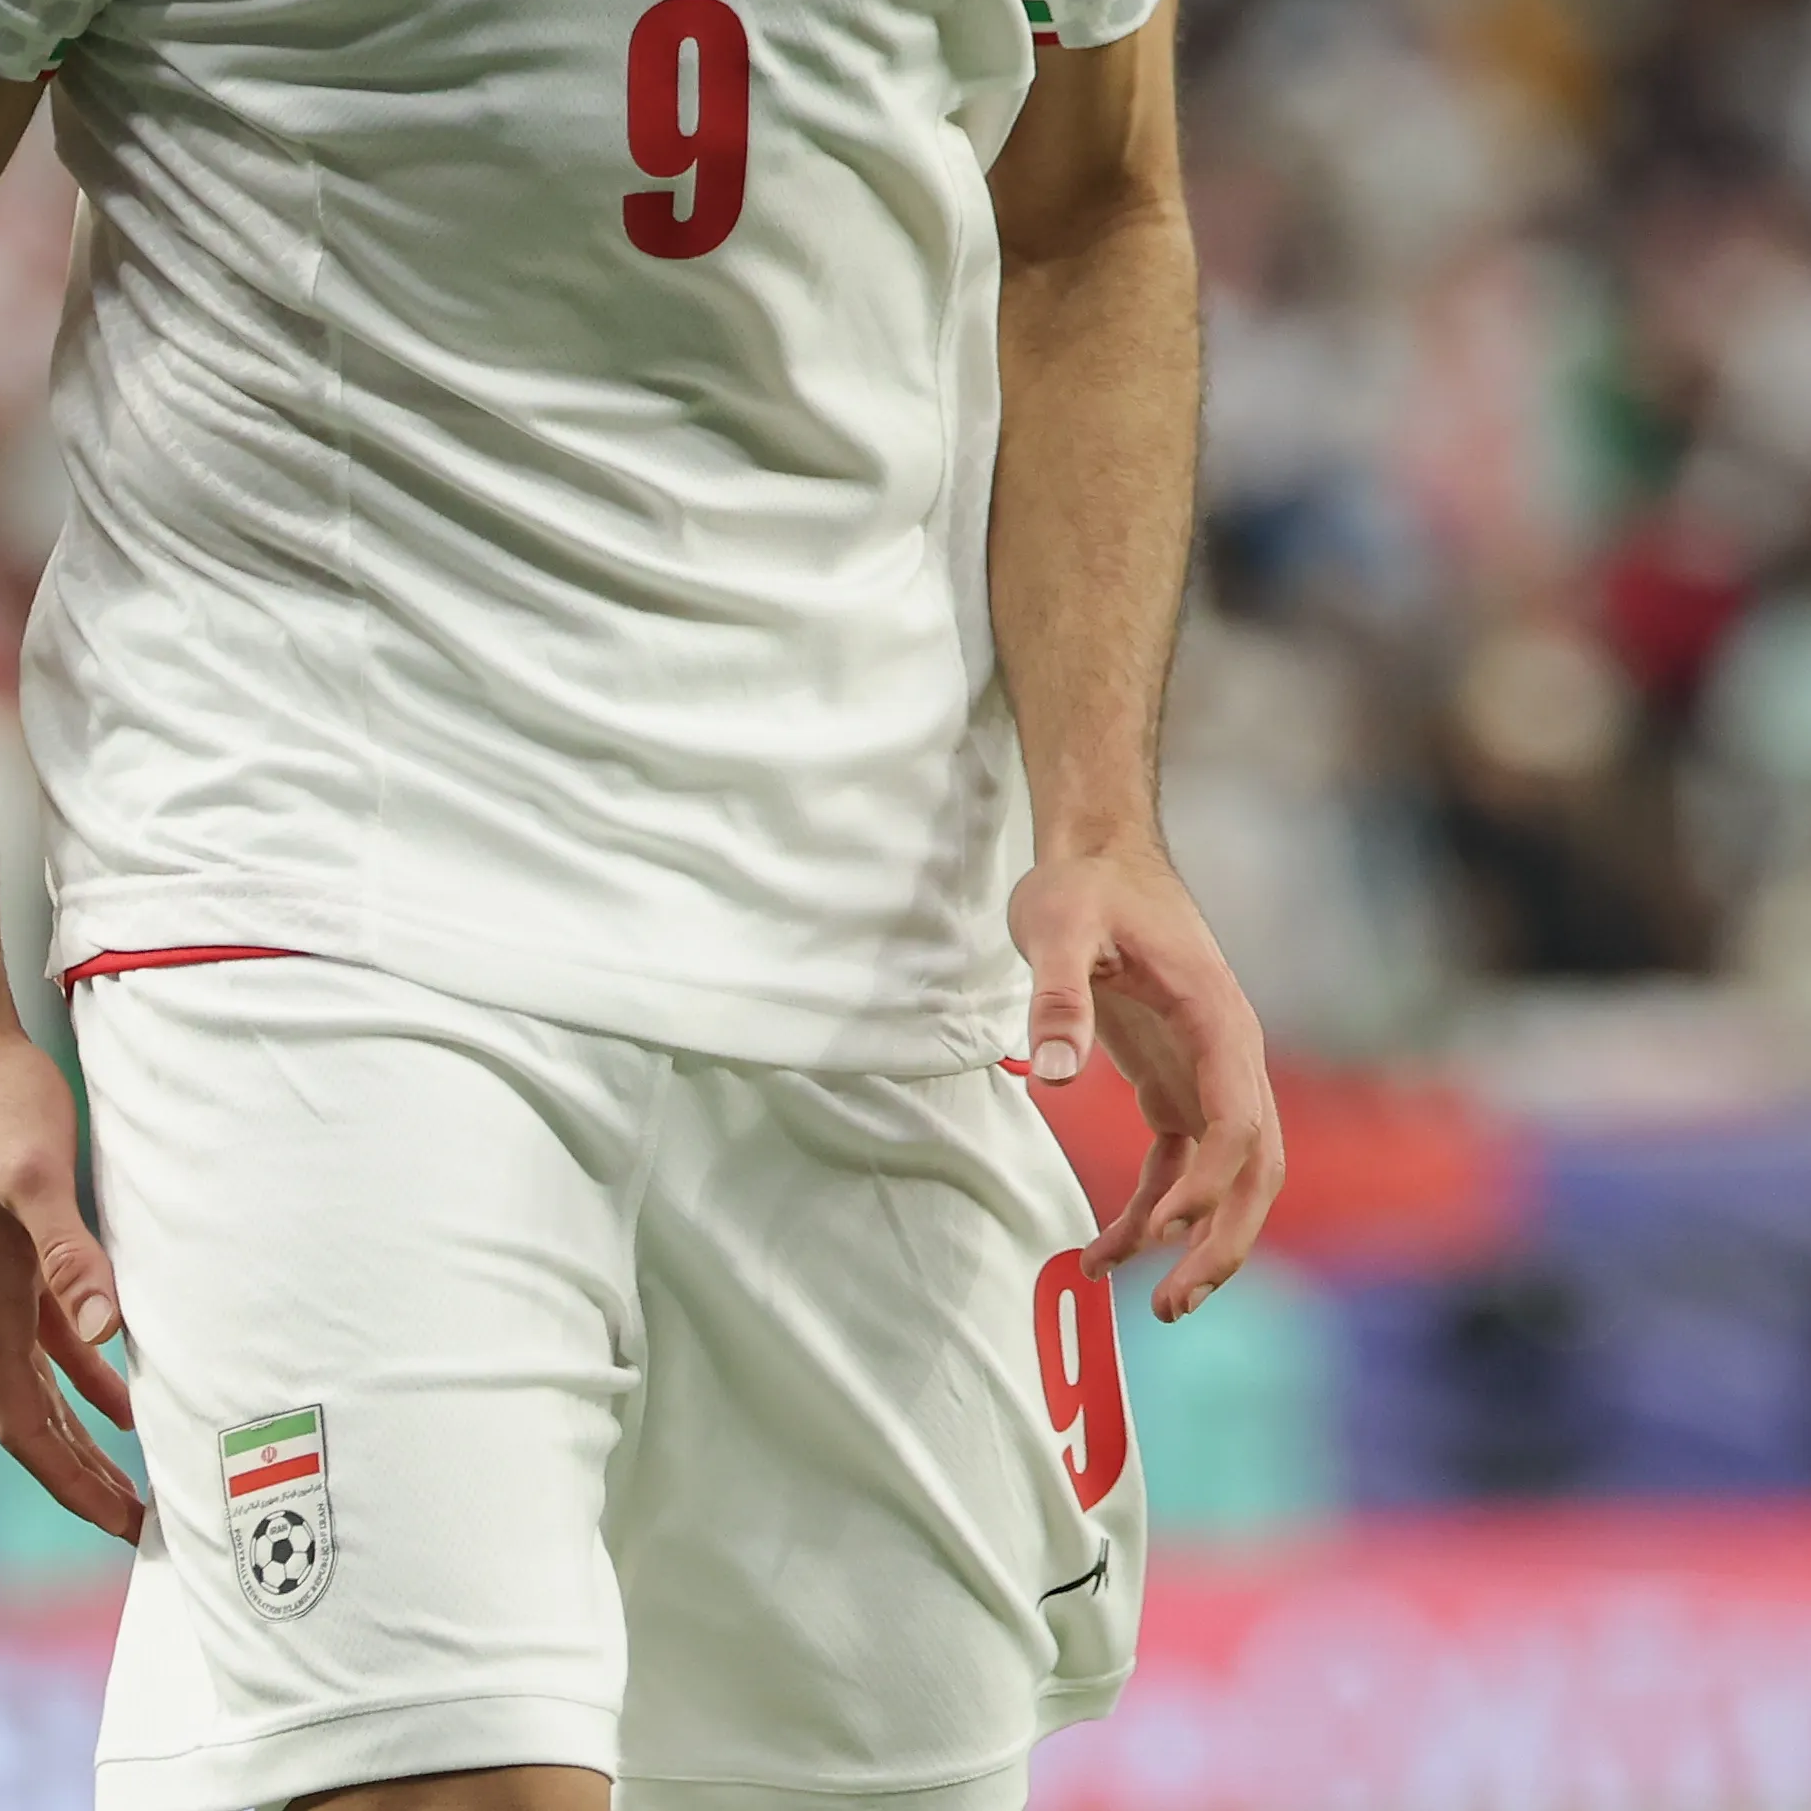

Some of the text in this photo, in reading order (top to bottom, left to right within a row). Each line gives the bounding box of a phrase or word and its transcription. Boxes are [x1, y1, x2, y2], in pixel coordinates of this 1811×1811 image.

[1033, 1248, 1128, 1513] 9
[235, 1528, 248, 1580] FOOTBALL
[270, 1524, 288, 1536] IRAN
